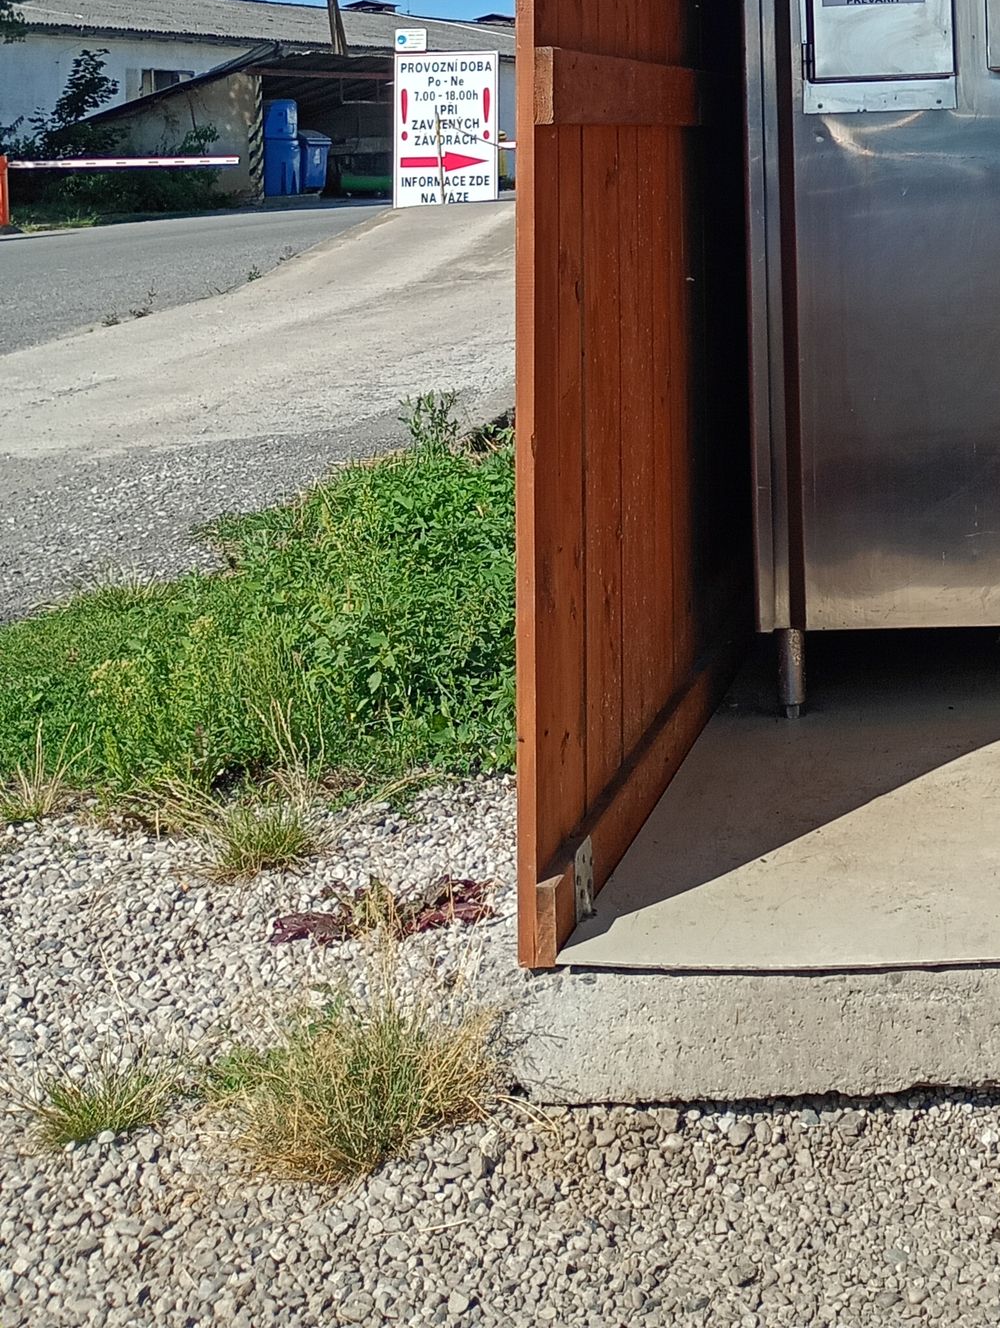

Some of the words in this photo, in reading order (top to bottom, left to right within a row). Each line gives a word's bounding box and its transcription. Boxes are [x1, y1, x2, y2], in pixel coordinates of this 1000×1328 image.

[400, 59, 458, 73] PROVOZNÍ
[460, 61, 492, 72] DOBA
[428, 76, 441, 87] Po
[451, 76, 464, 86] Ne
[414, 91, 436, 102] 7.00
[445, 89, 478, 100] 18.00h
[411, 116, 480, 130] ZAVENÝCH
[401, 176, 466, 187] INFORMACE
[468, 175, 490, 186] ZDE
[421, 192, 437, 203] NA
